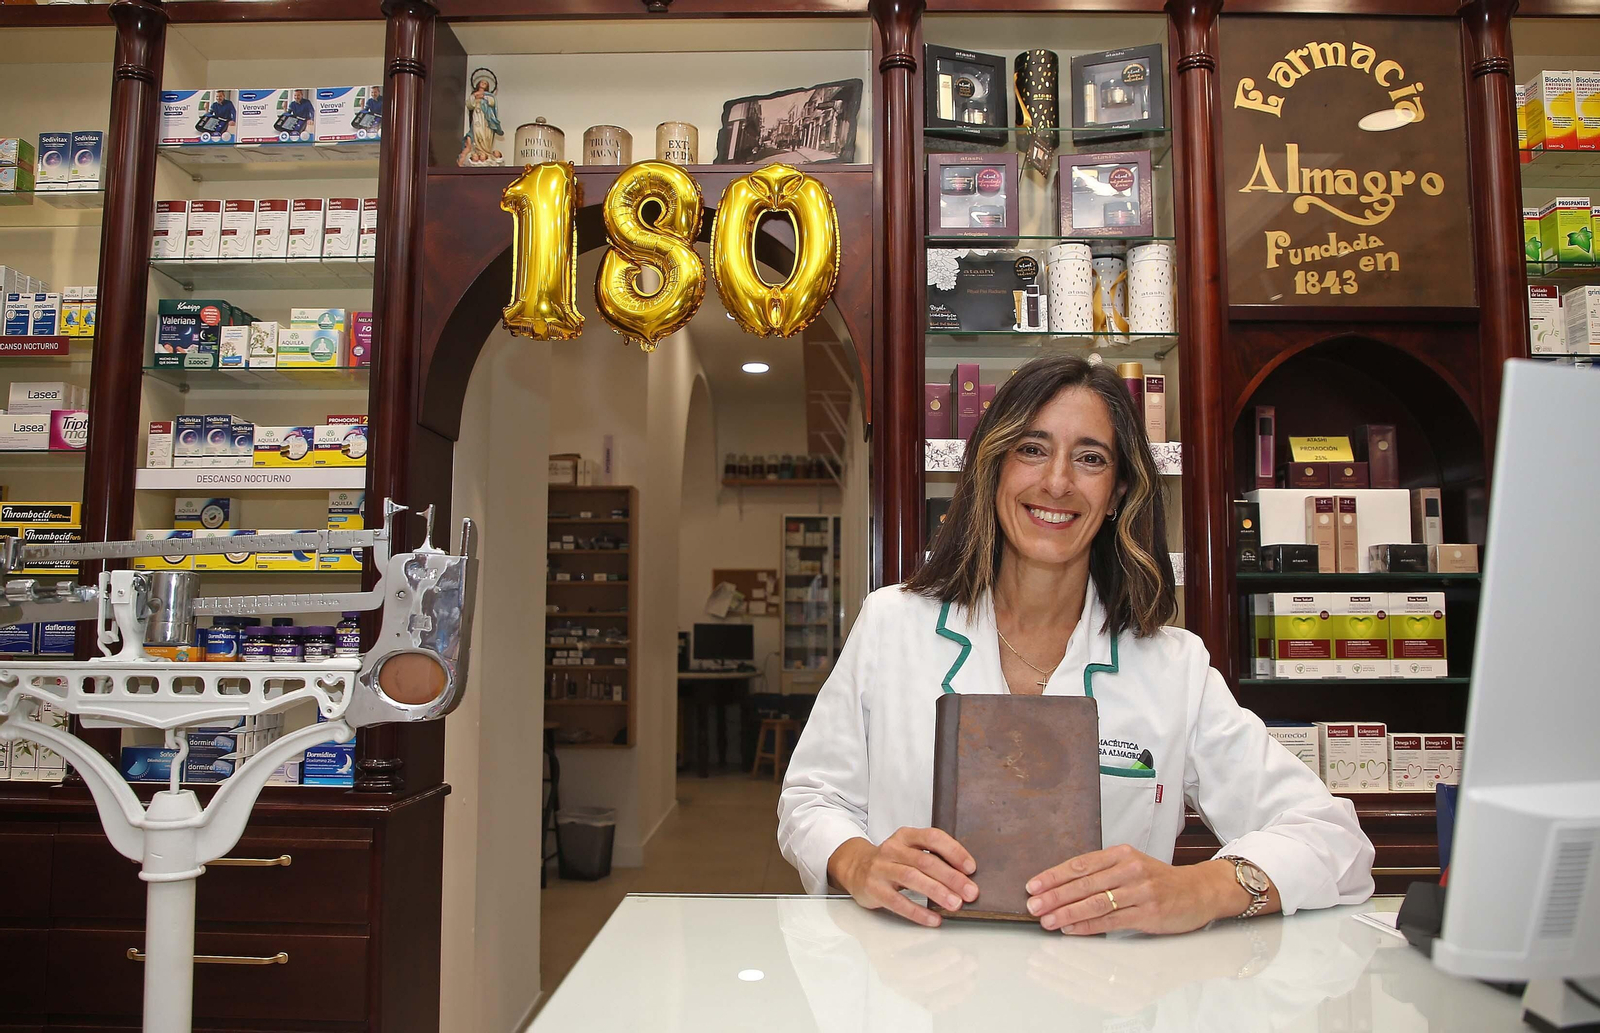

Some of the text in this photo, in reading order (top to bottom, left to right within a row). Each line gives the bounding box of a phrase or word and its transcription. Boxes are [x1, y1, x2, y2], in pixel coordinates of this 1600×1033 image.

[591, 138, 620, 147] TRIACA
[668, 140, 690, 150] EXT.
[590, 149, 618, 158] MAGNA
[665, 151, 694, 162] RUDA
[1238, 143, 1445, 226] Almagro
[1264, 230, 1400, 272] Fundada en
[1294, 270, 1358, 295] 1843
[177, 302, 200, 312] Kneipp
[162, 317, 196, 325] Valeriana
[28, 390, 57, 399] Lasea
[14, 423, 44, 432] Lasea
[63, 416, 88, 430] Tript
[2, 507, 51, 518] Thrombocid
[26, 529, 72, 540] Thrombocid
[1108, 750, 1141, 760] ALMAGRO
